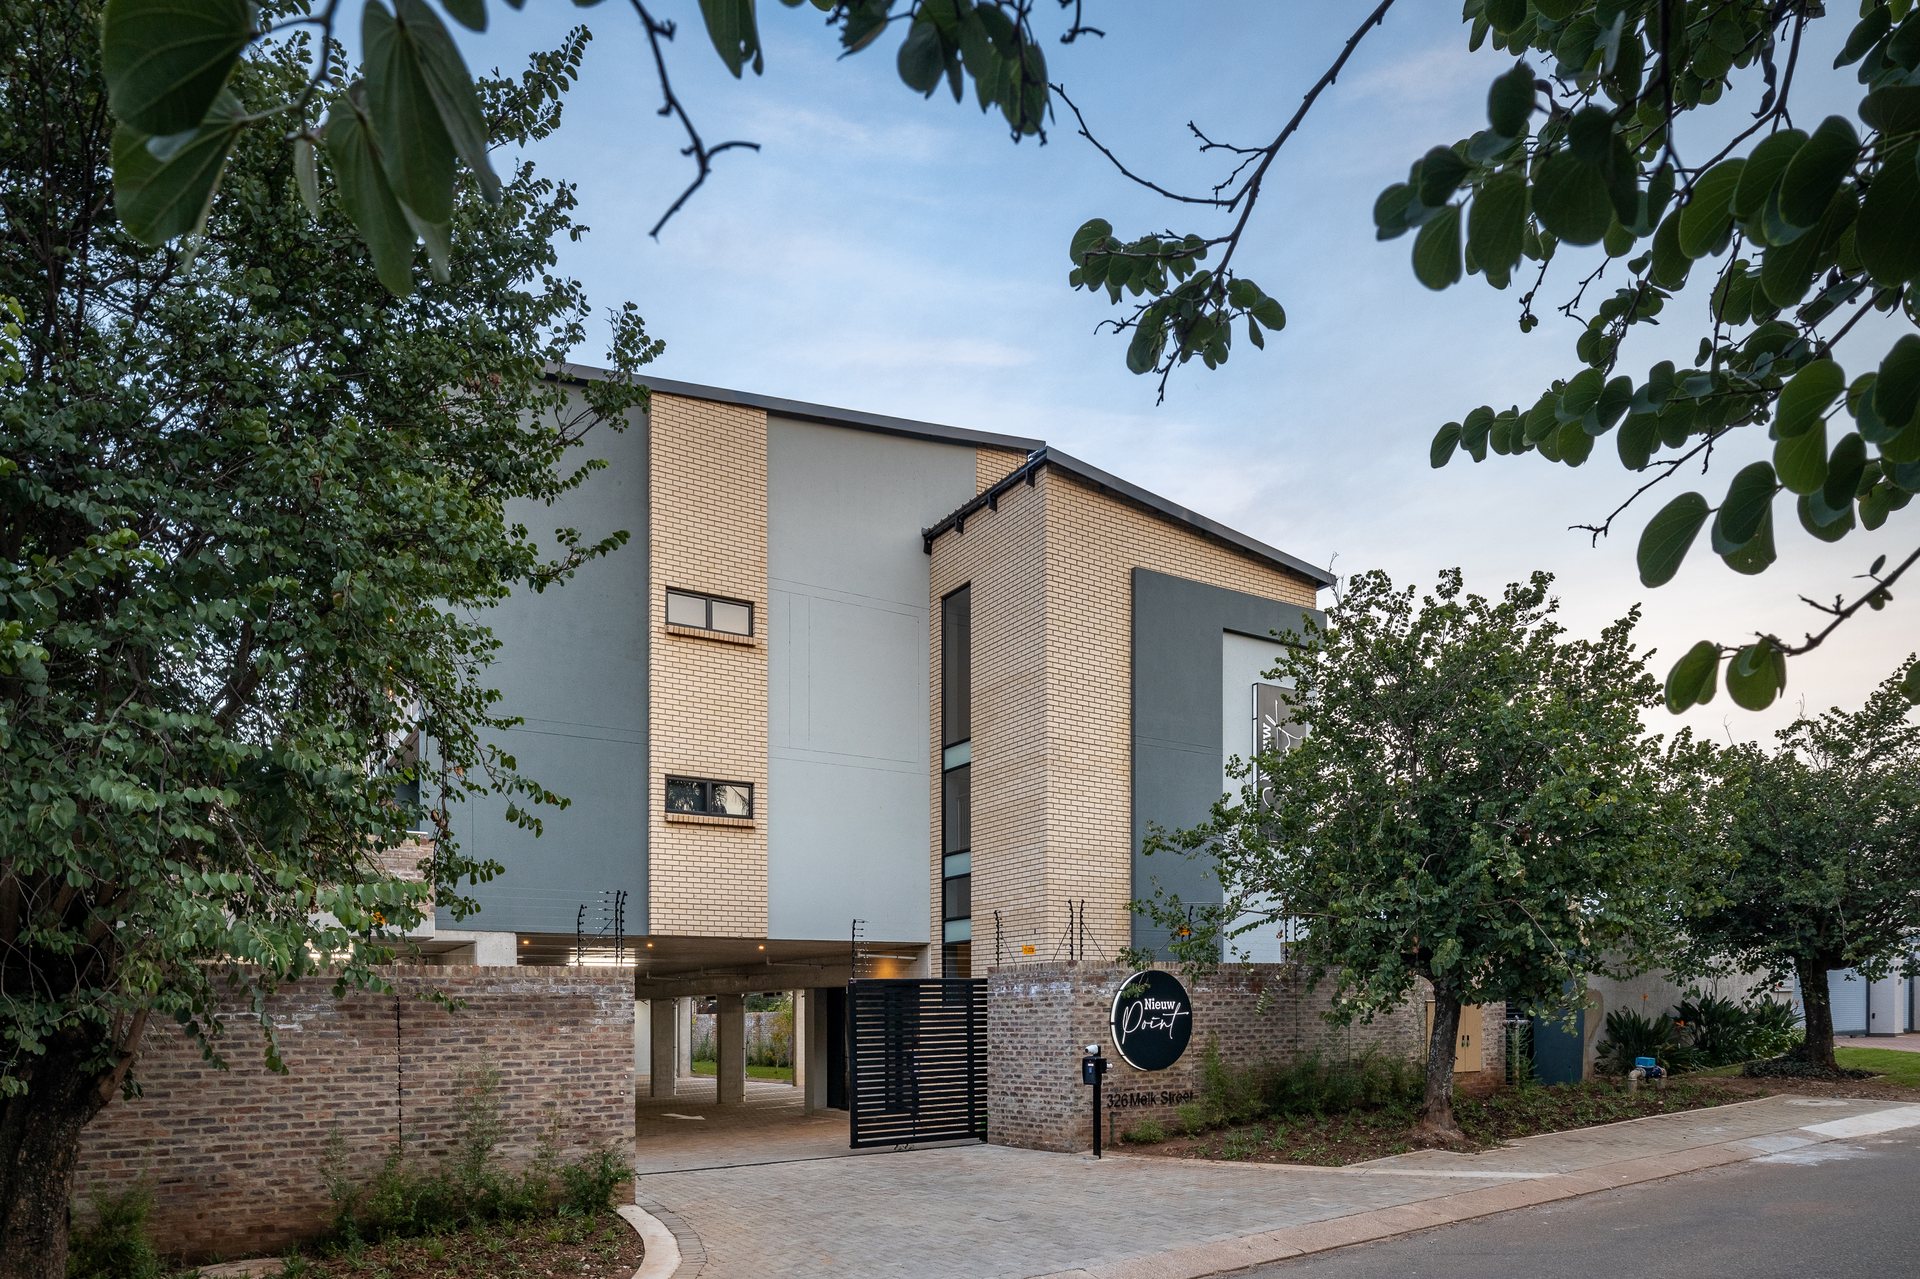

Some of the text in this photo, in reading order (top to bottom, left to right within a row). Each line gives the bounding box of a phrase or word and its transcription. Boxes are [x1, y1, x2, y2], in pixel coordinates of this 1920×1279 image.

[1144, 997, 1176, 1010] Nieuw
[1121, 1001, 1190, 1045] Point
[1106, 1090, 1193, 1108] 326 Melk Street
